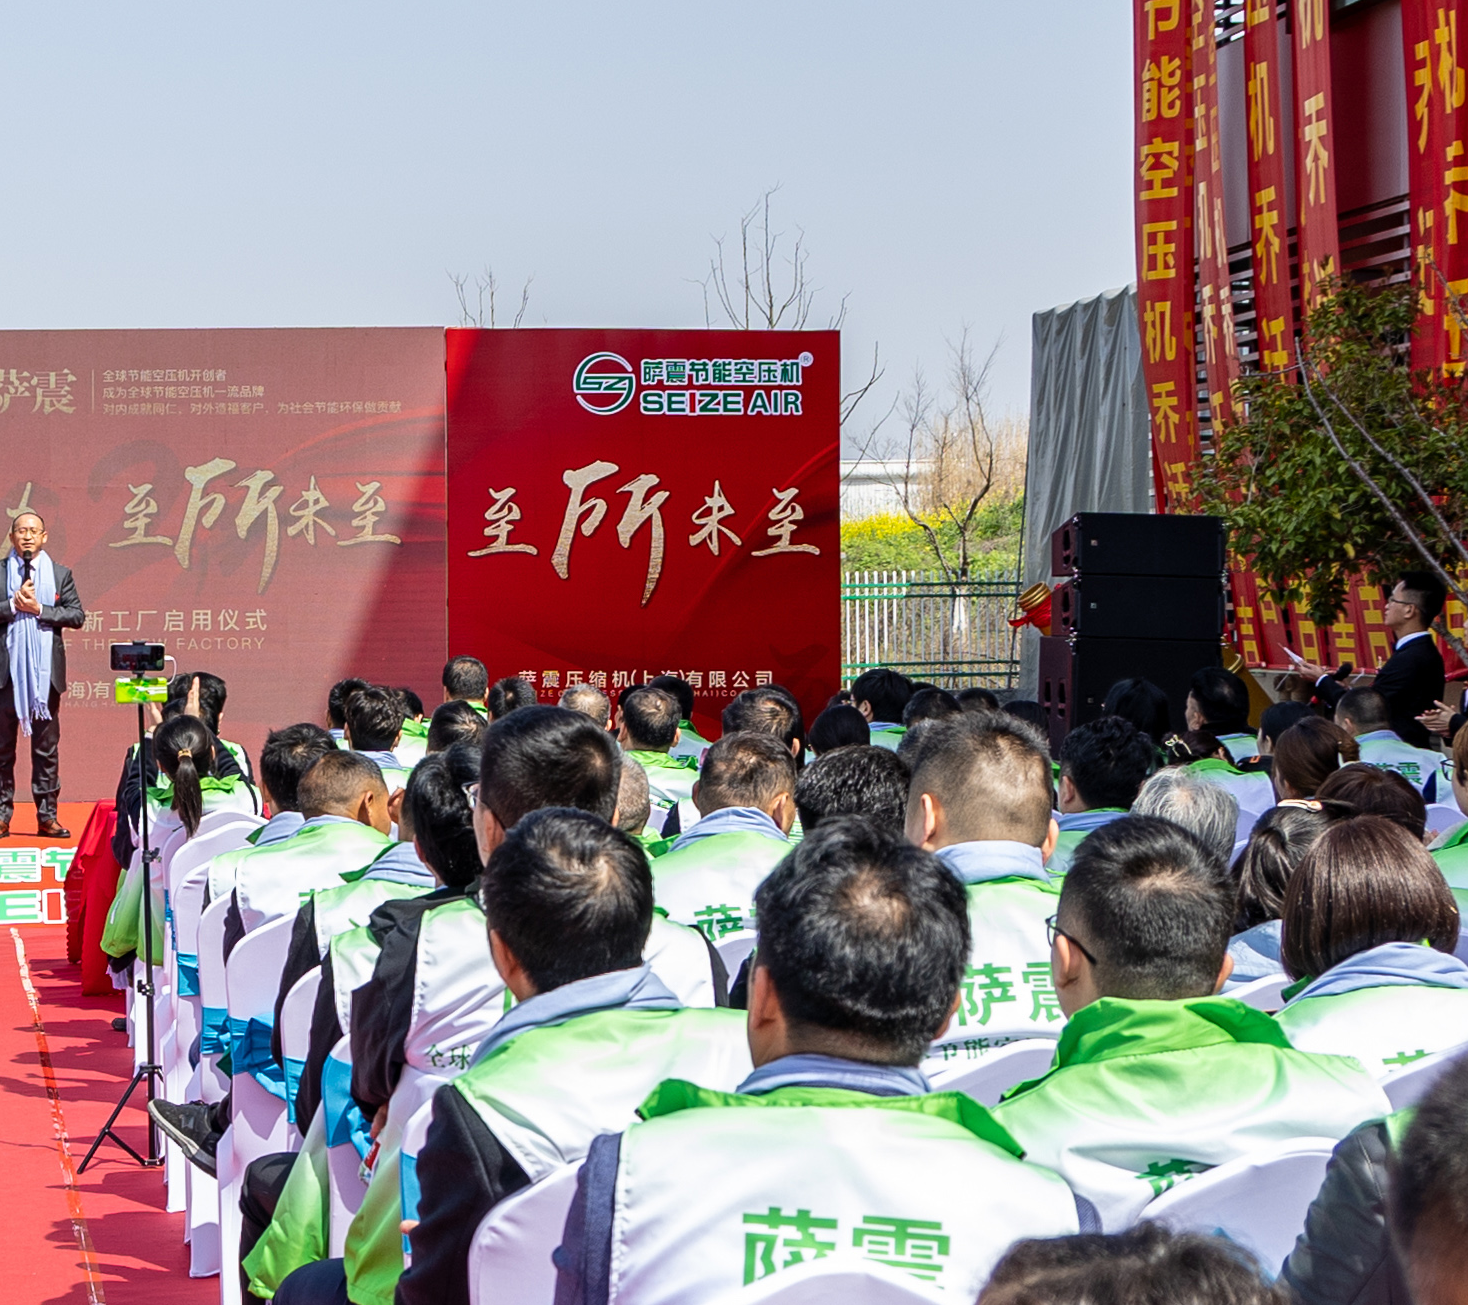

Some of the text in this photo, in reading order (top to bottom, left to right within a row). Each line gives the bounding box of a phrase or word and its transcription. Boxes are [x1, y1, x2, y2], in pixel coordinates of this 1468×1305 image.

[641, 360, 802, 385] 萨震节能空压机
[640, 391, 803, 415] SEIZE AIR
[65, 608, 268, 633] 新工厂启用仪式
[175, 637, 266, 651] FACTORY
